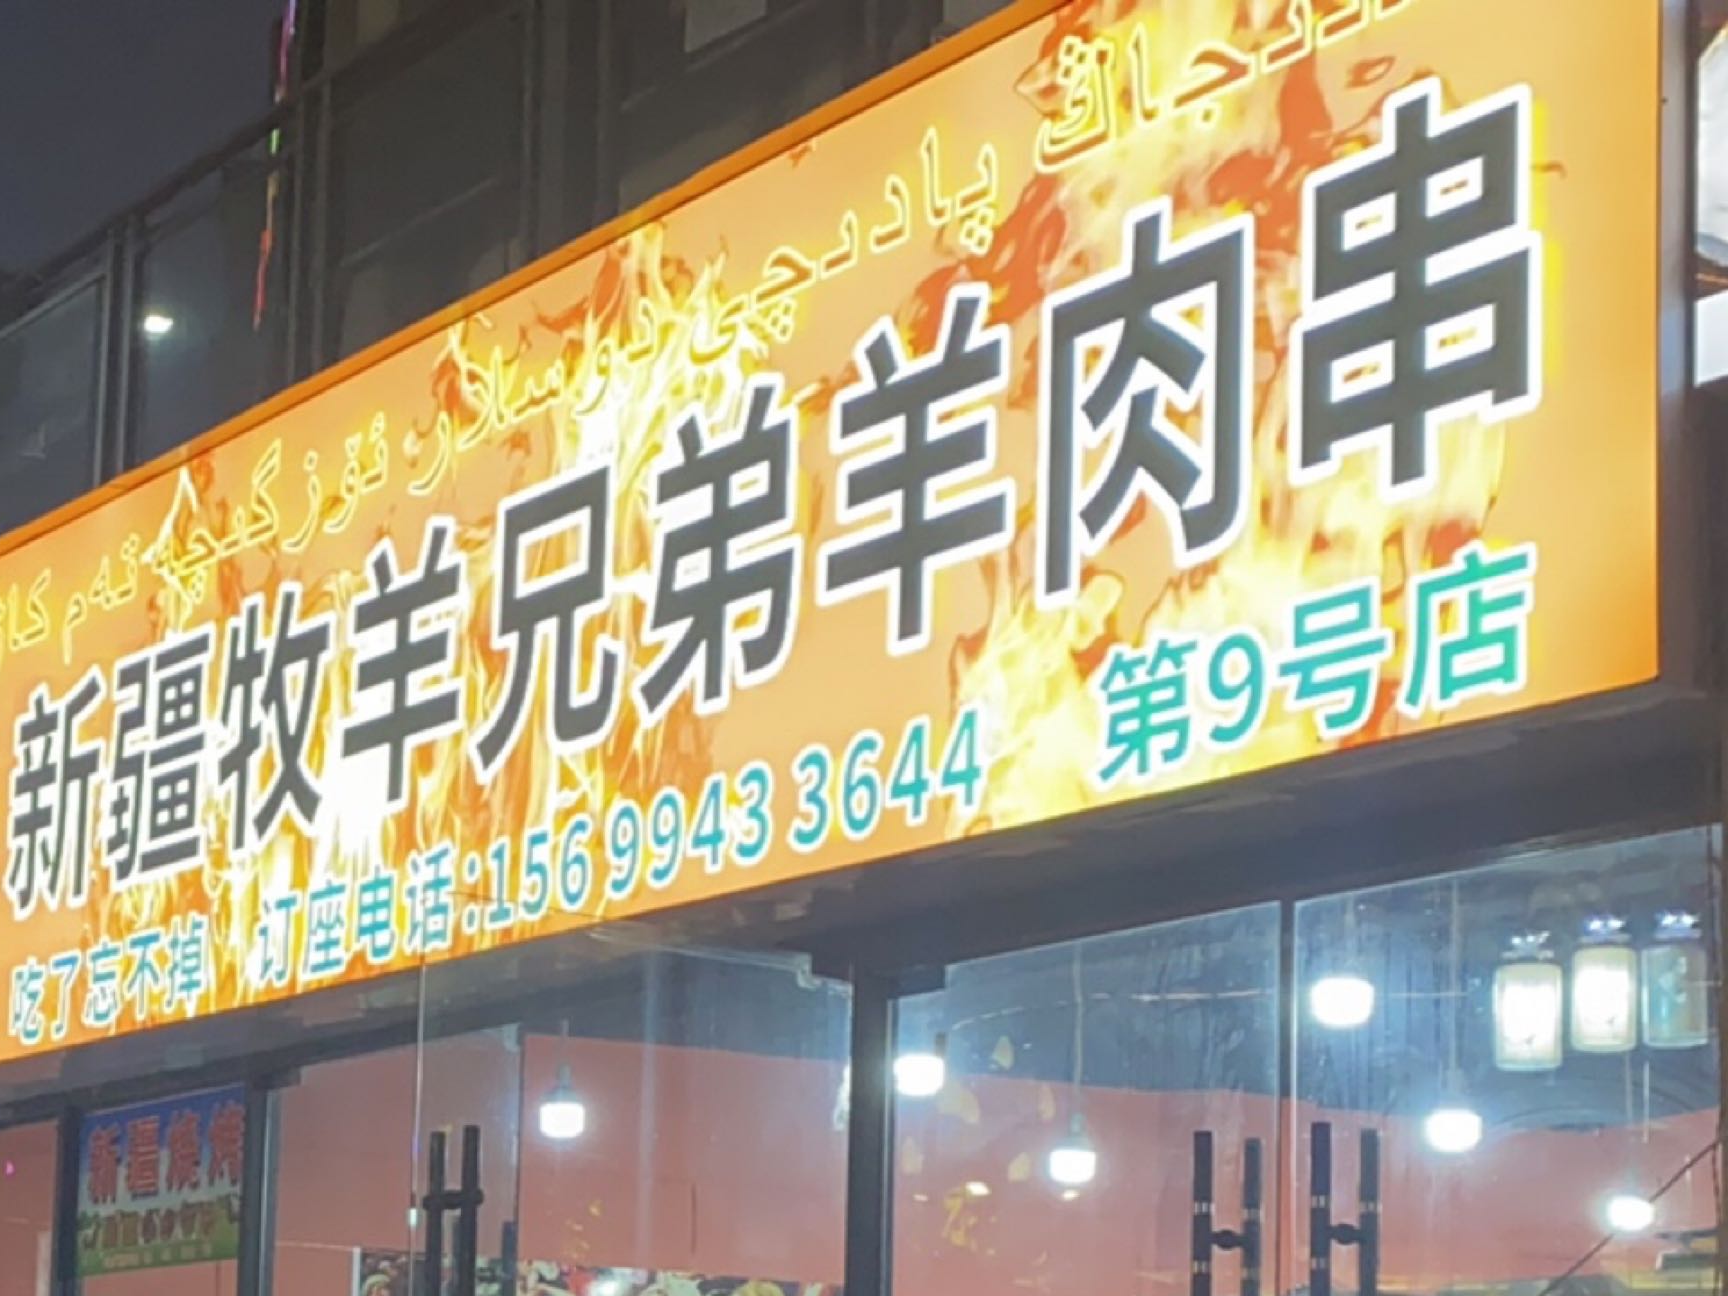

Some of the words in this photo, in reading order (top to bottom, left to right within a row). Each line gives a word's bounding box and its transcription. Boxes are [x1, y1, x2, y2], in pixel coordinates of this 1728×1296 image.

[4, 86, 1532, 907] 新疆牧羊兄弟羊肉串
[1096, 550, 1534, 780] 第9号店
[10, 920, 207, 1042] 吃了忘不掉
